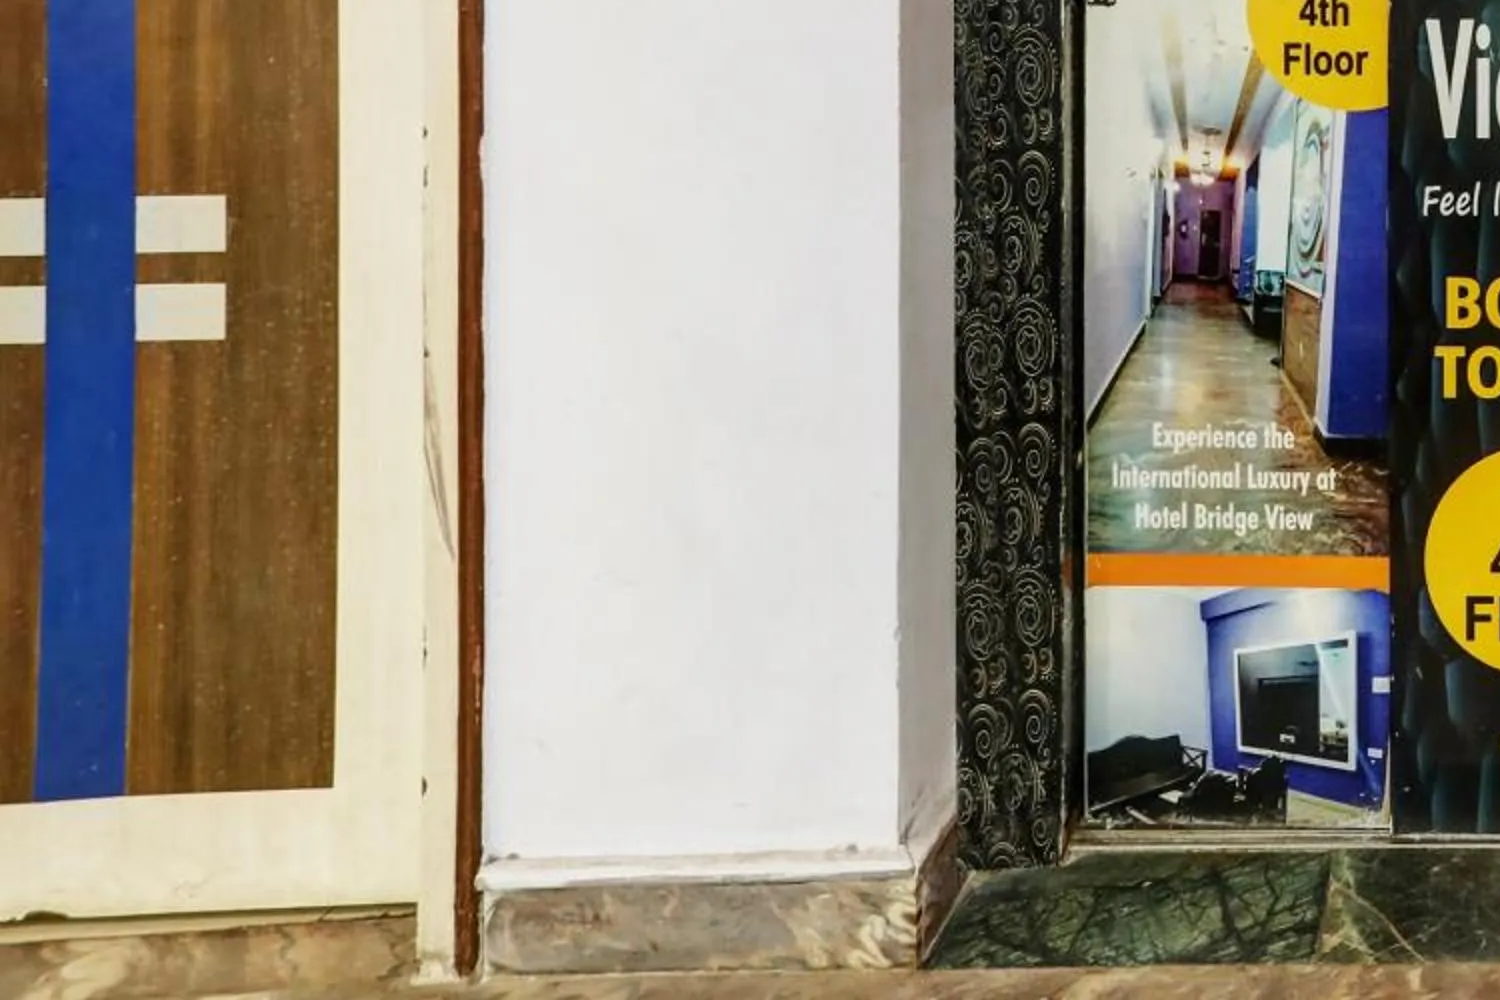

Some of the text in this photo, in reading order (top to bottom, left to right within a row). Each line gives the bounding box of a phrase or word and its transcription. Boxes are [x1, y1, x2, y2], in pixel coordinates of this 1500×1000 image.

[1283, 43, 1369, 76] Floor
[1422, 181, 1481, 217] Feel
[1152, 422, 1295, 453] Experience the
[1111, 462, 1337, 496] International Luxury at
[1135, 503, 1314, 535] Hotel Bridge View
